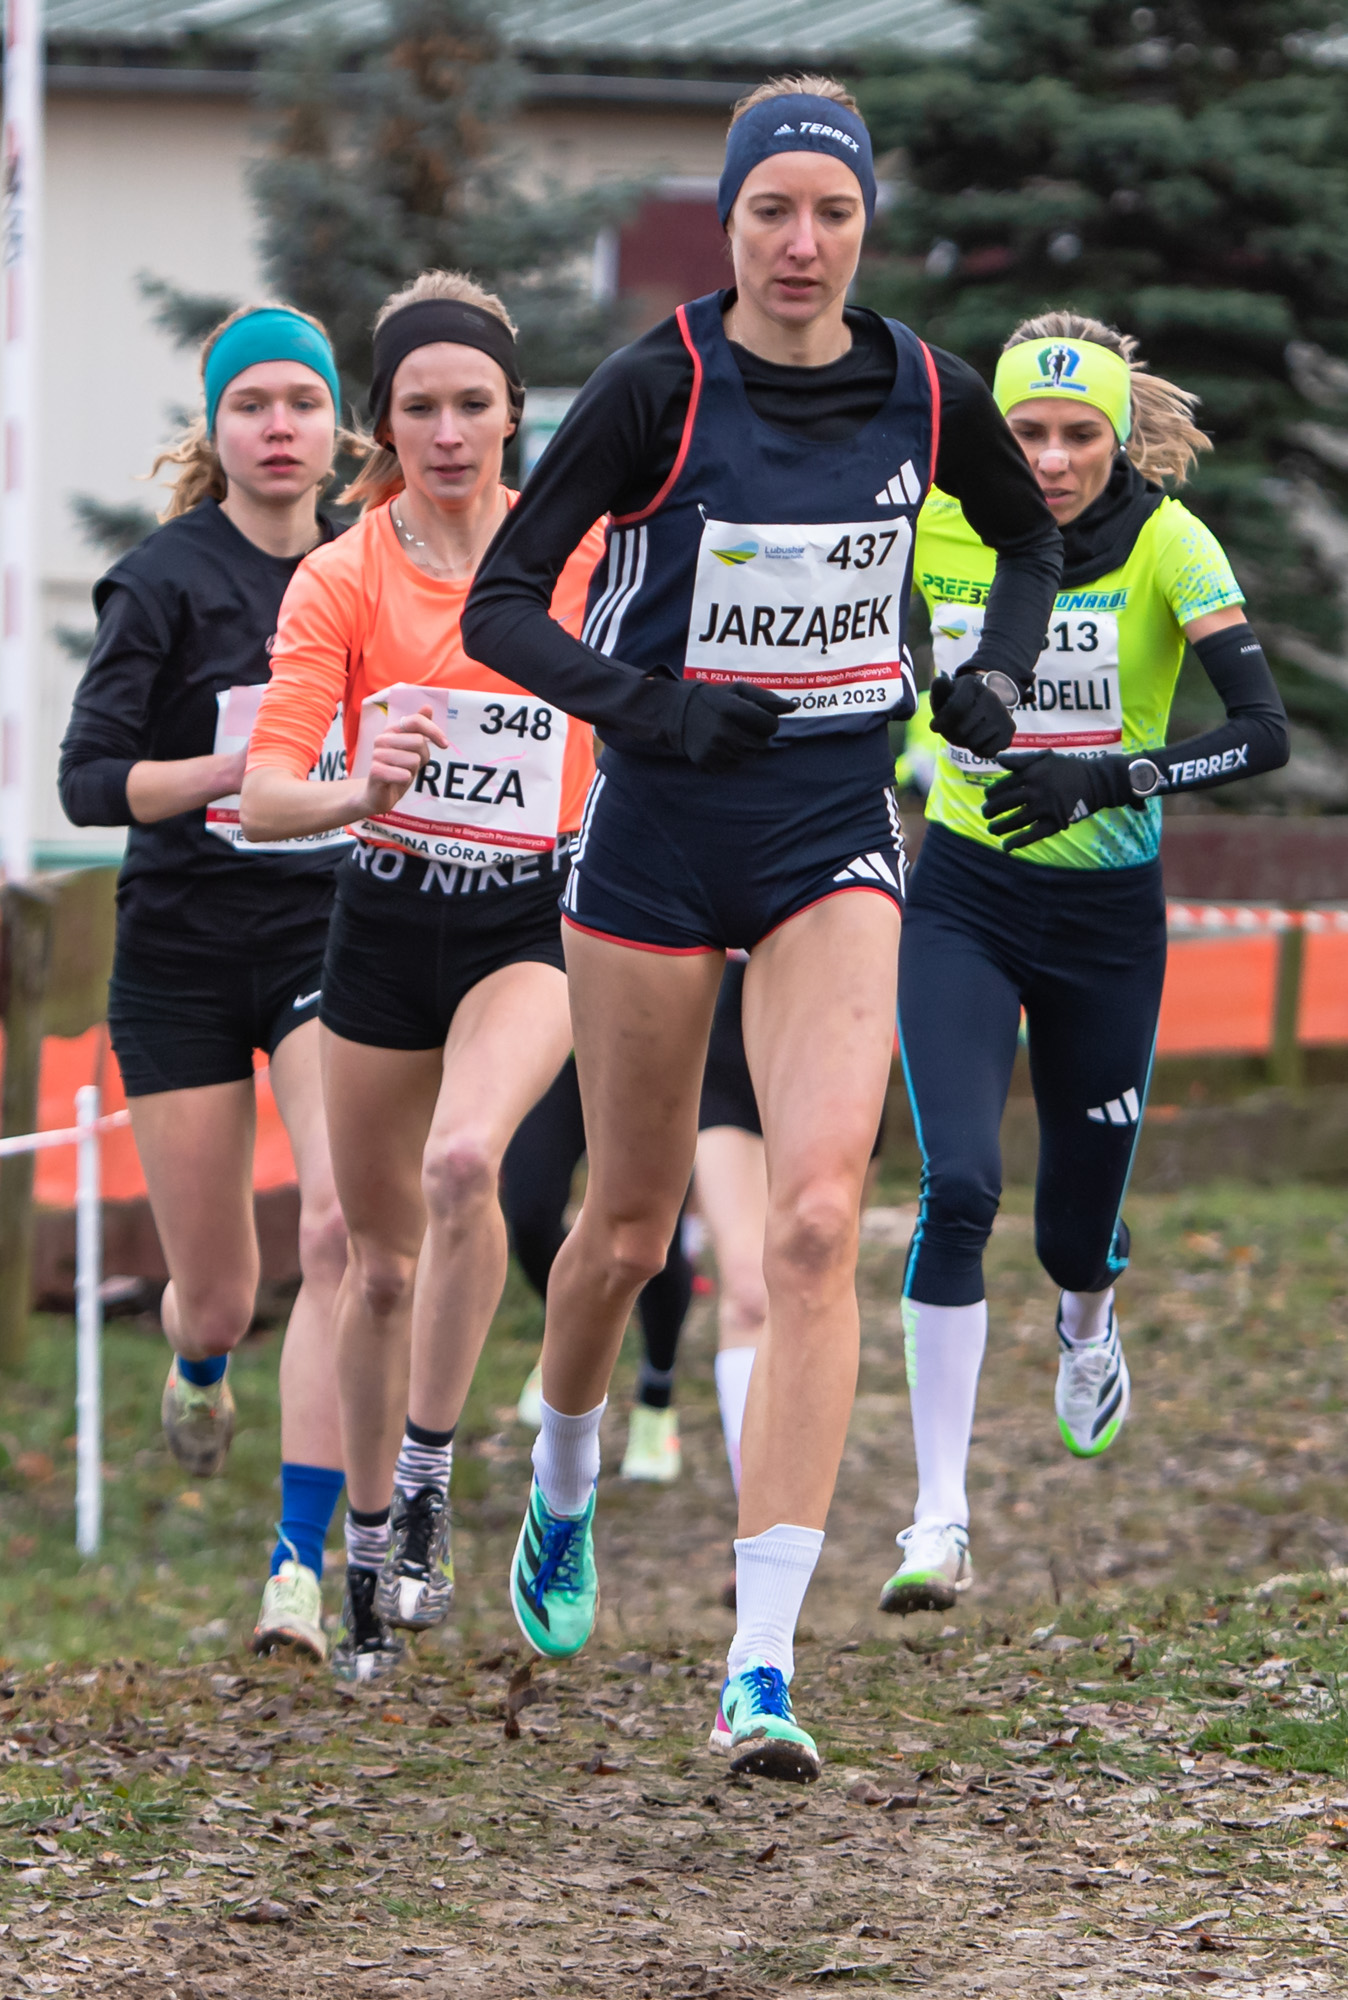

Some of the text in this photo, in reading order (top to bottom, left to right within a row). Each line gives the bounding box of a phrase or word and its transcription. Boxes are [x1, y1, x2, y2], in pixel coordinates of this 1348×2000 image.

[800, 121, 860, 153] TERREX
[827, 530, 898, 570] 437
[698, 595, 893, 654] JARZĄBEK
[842, 687, 887, 705] 2023
[480, 703, 552, 741] 348
[1168, 743, 1248, 785] TERREX
[434, 842, 487, 863] GÓRA
